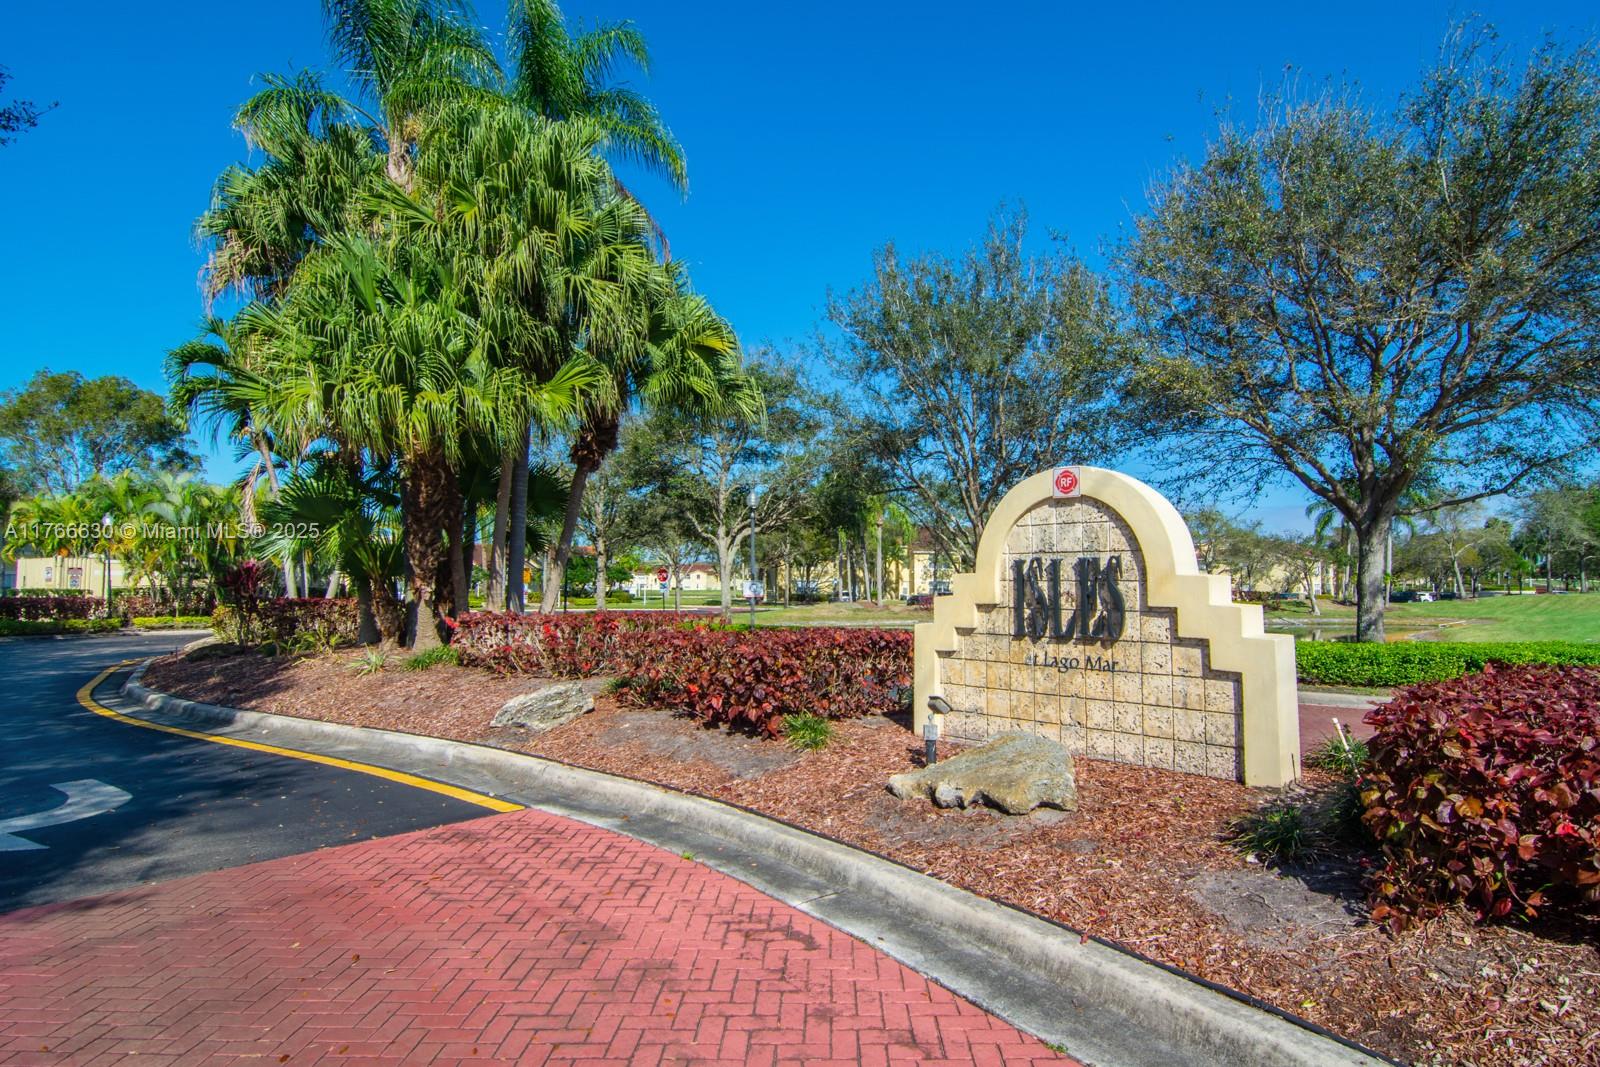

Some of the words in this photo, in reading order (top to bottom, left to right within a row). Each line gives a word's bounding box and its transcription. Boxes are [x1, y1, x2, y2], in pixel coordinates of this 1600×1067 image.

[1060, 477, 1073, 488] RF
[1012, 555, 1125, 640] ISLES
[1043, 650, 1080, 673] Lago
[1084, 655, 1119, 672] Mar
